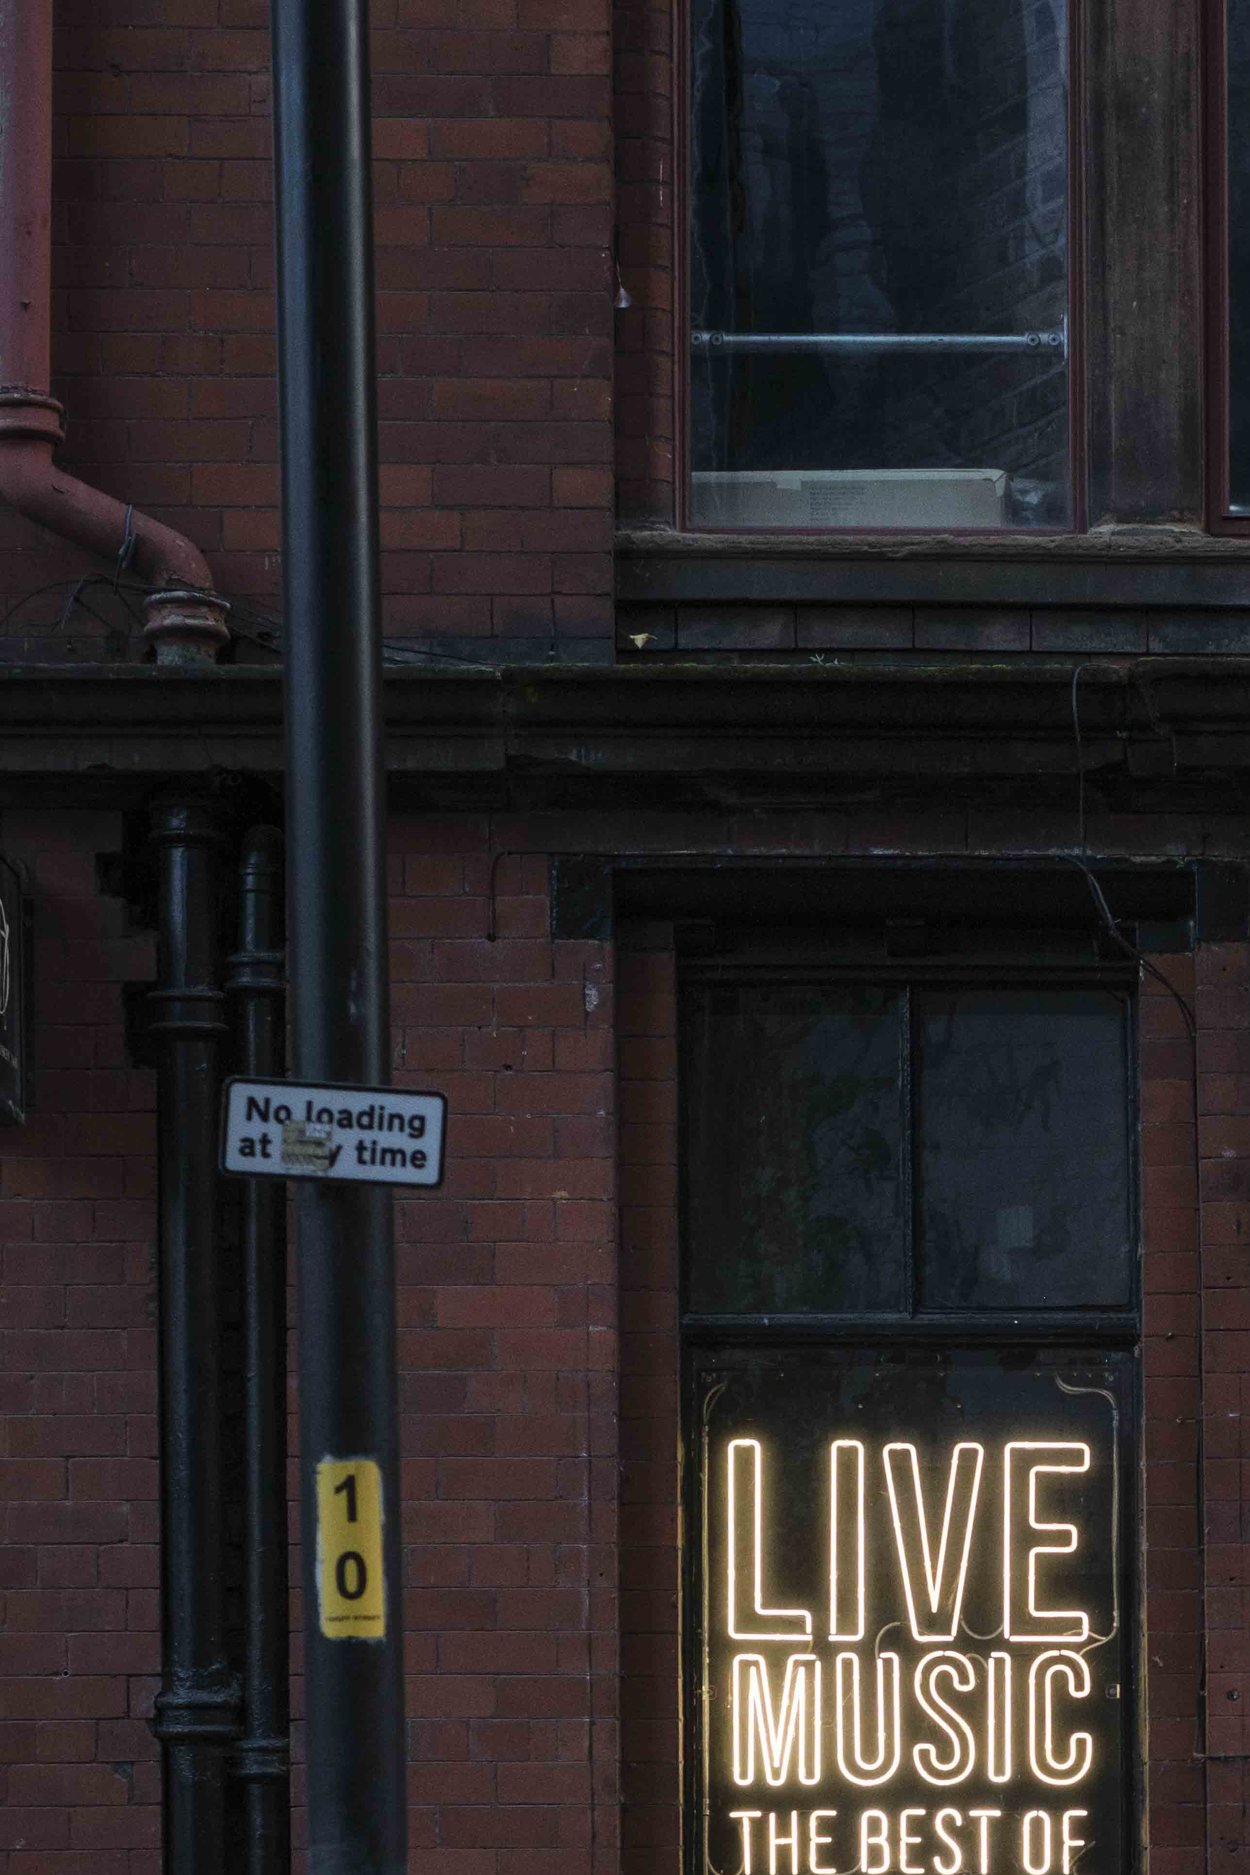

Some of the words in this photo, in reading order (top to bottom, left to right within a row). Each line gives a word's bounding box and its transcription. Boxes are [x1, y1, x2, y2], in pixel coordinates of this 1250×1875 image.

[239, 1133, 272, 1158] at
[355, 1140, 427, 1169] time
[246, 1096, 291, 1124] No
[306, 1101, 426, 1139] loading
[728, 1439, 1091, 1641] LIVE
[732, 1648, 1092, 1786] MUSIC
[729, 1809, 837, 1875] THE
[861, 1808, 1001, 1875] BEST
[1022, 1808, 1088, 1875] OF
